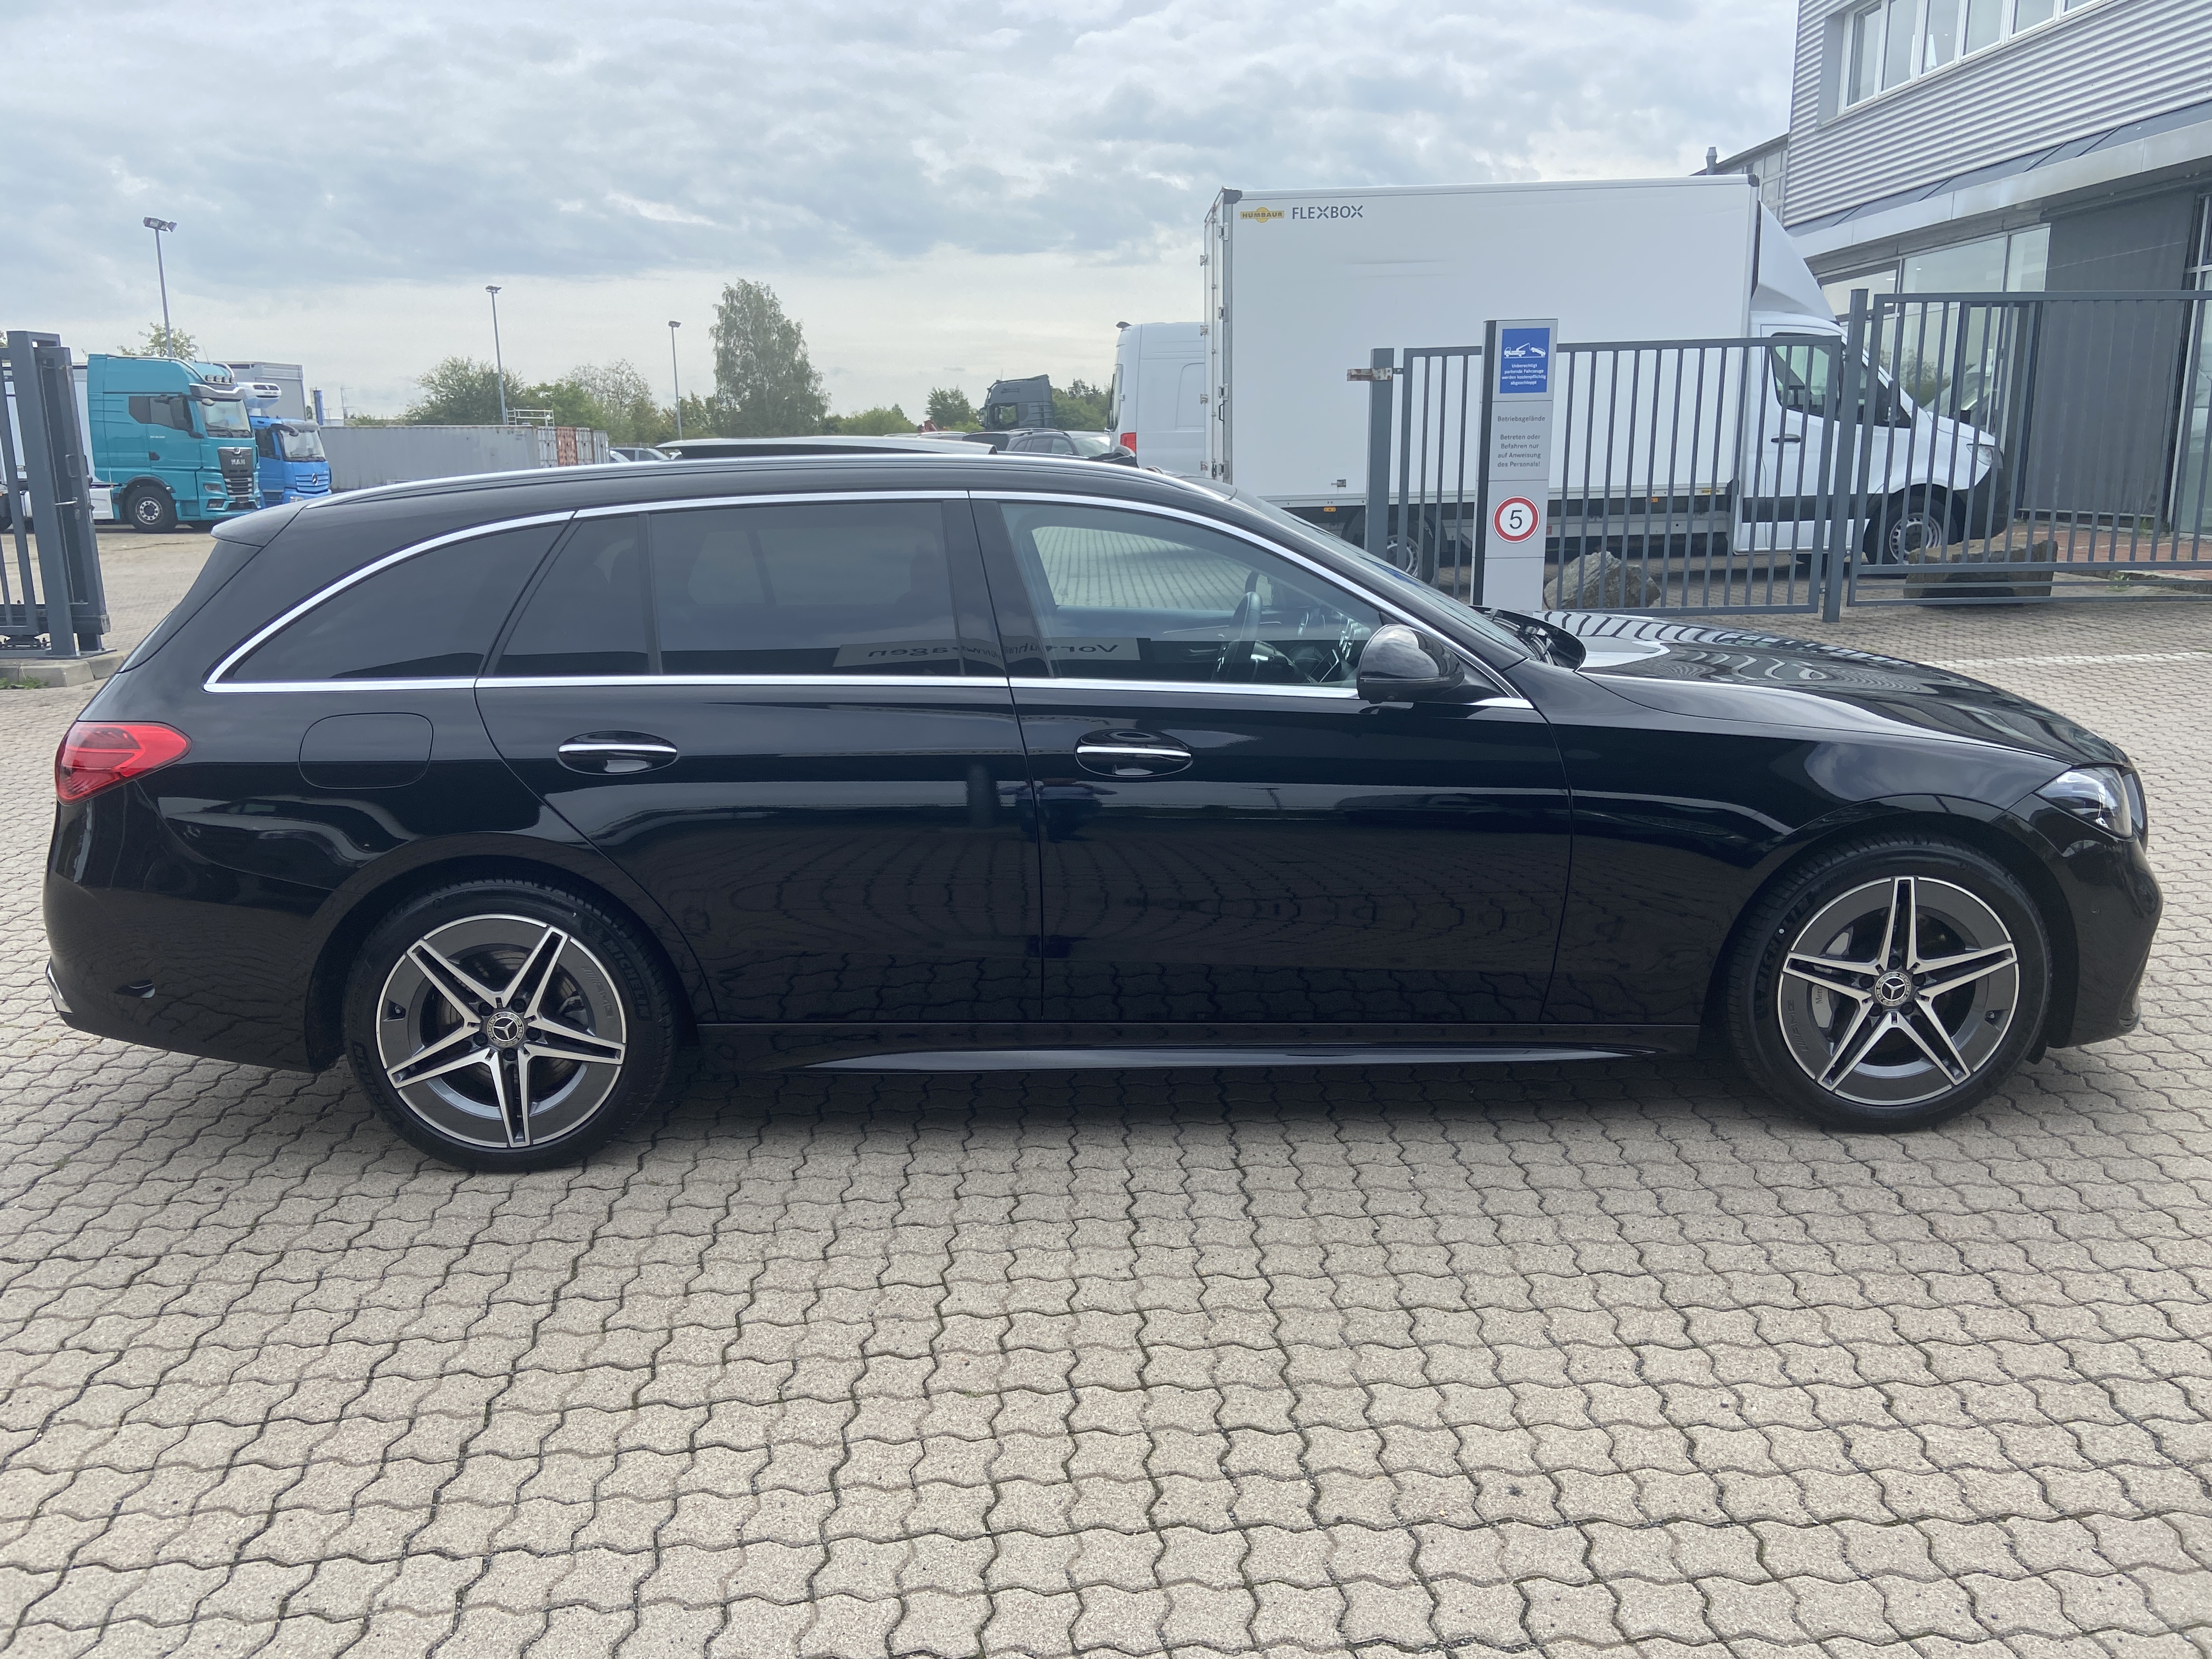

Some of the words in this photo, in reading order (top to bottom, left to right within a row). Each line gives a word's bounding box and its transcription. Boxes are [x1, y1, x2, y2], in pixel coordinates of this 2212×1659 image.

[1292, 205, 1363, 219] FLEXBOX
[1509, 510, 1522, 529] 5
[602, 939, 651, 1018] MICHELIN
